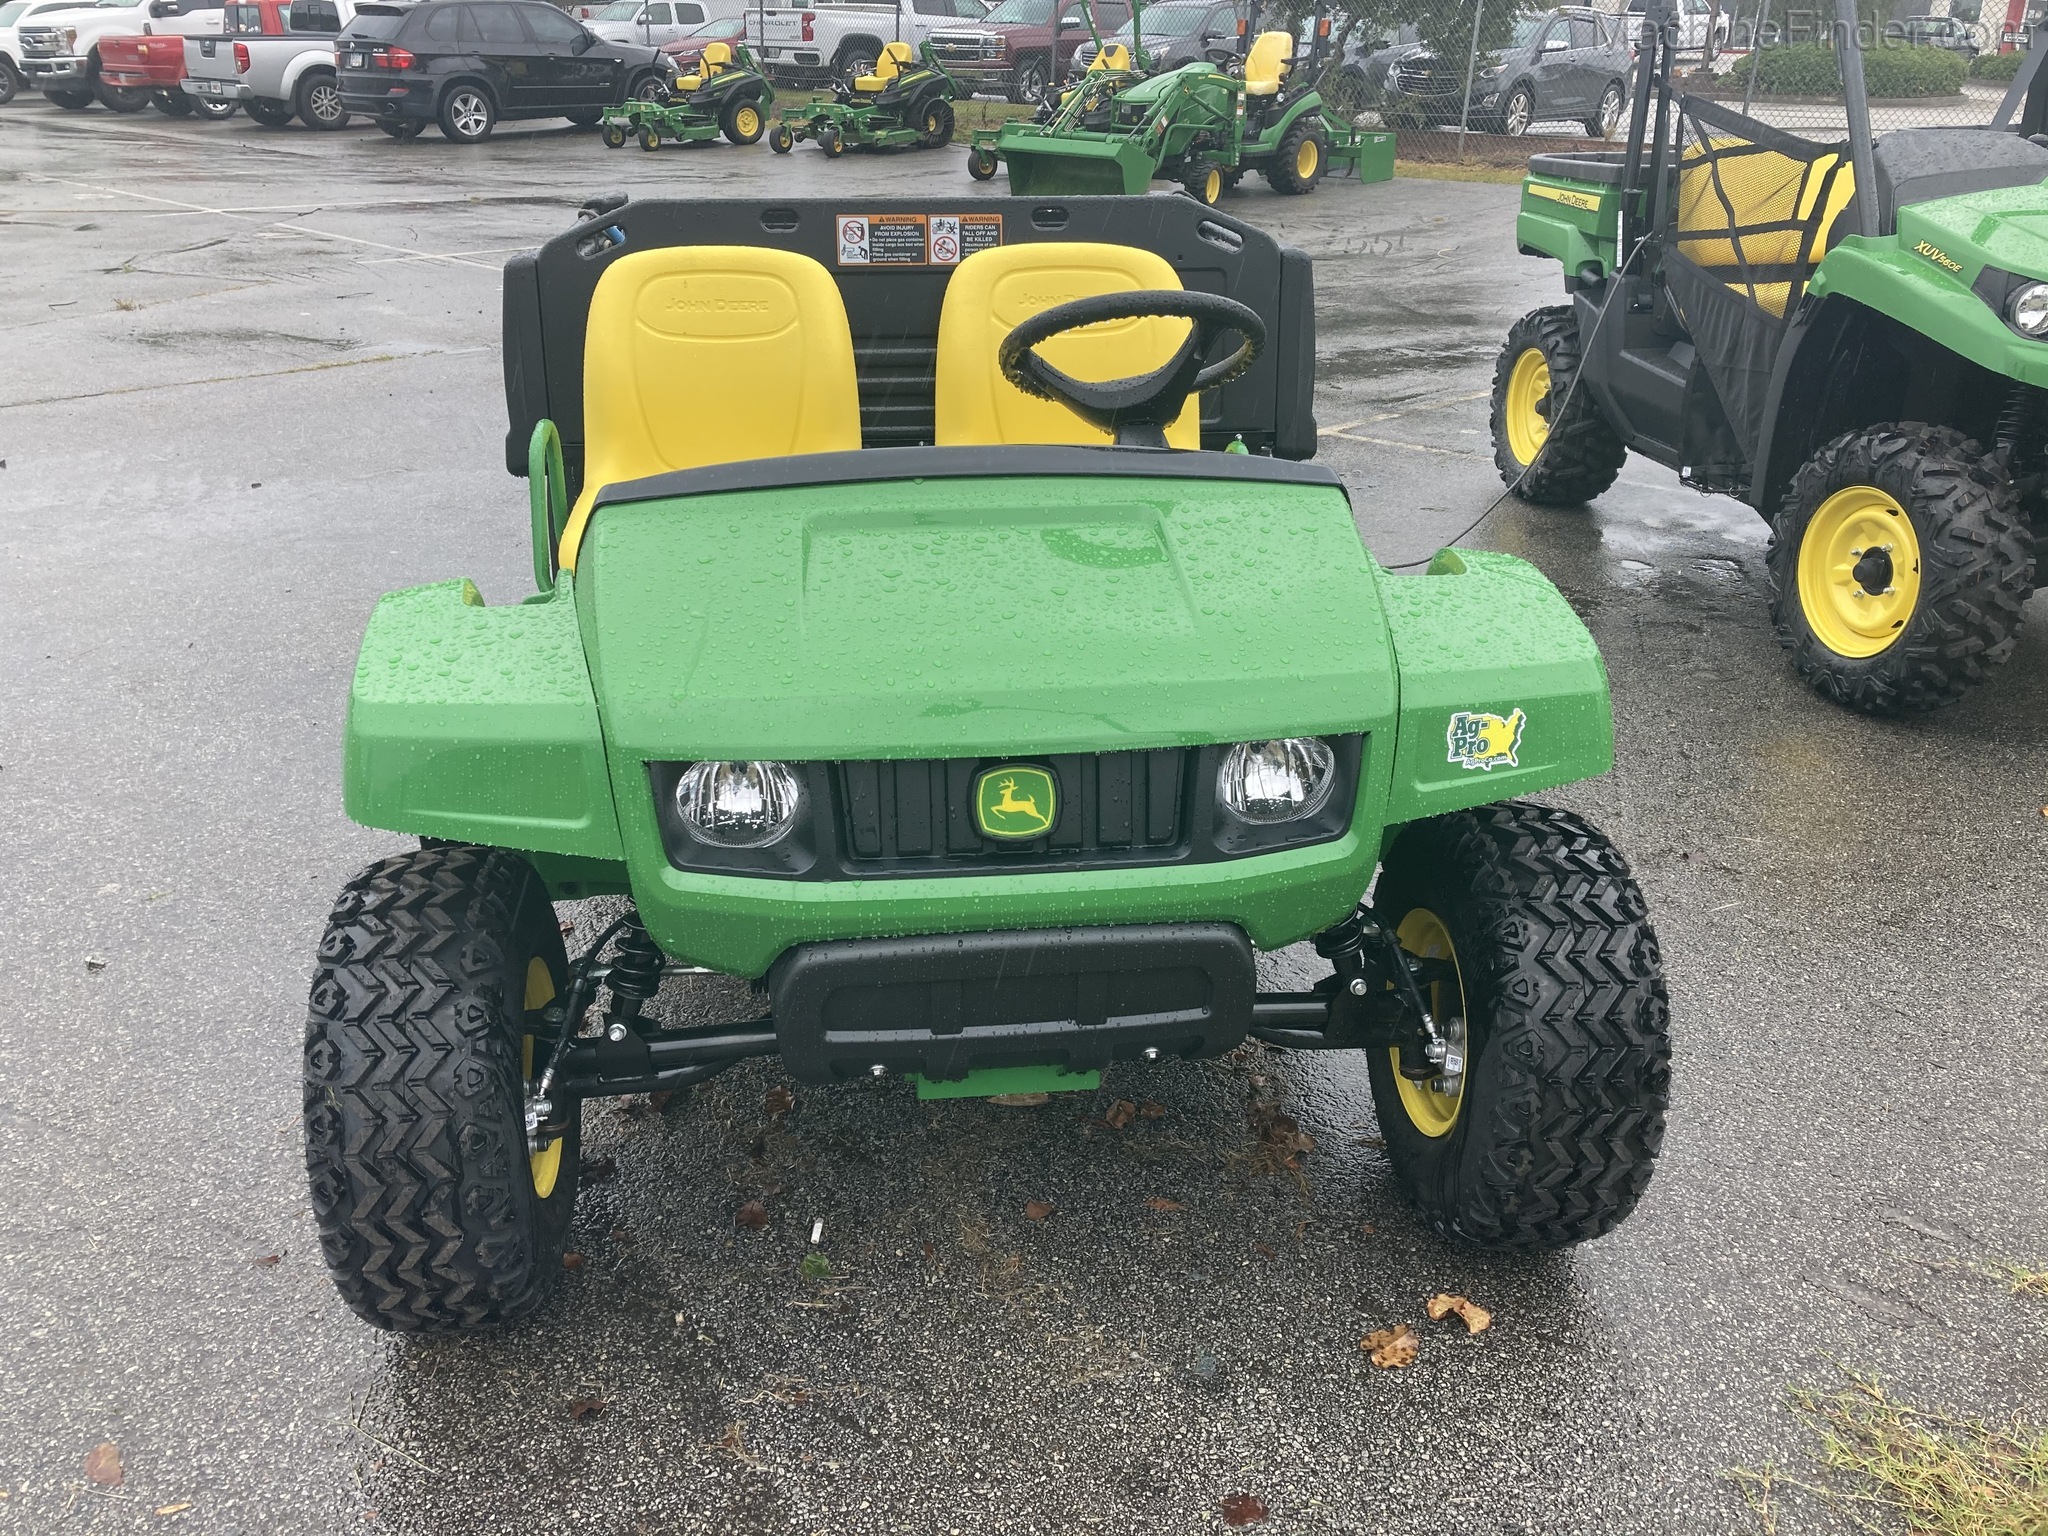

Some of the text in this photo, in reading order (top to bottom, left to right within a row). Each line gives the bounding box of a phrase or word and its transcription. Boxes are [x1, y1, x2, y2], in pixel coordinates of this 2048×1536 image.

[1557, 192, 1588, 209] JOHN DEERE
[1912, 239, 1964, 273] XUV560E
[665, 297, 769, 313] JOHN DEERE
[1452, 715, 1489, 739] Ag-
[1452, 737, 1490, 758] Pro
